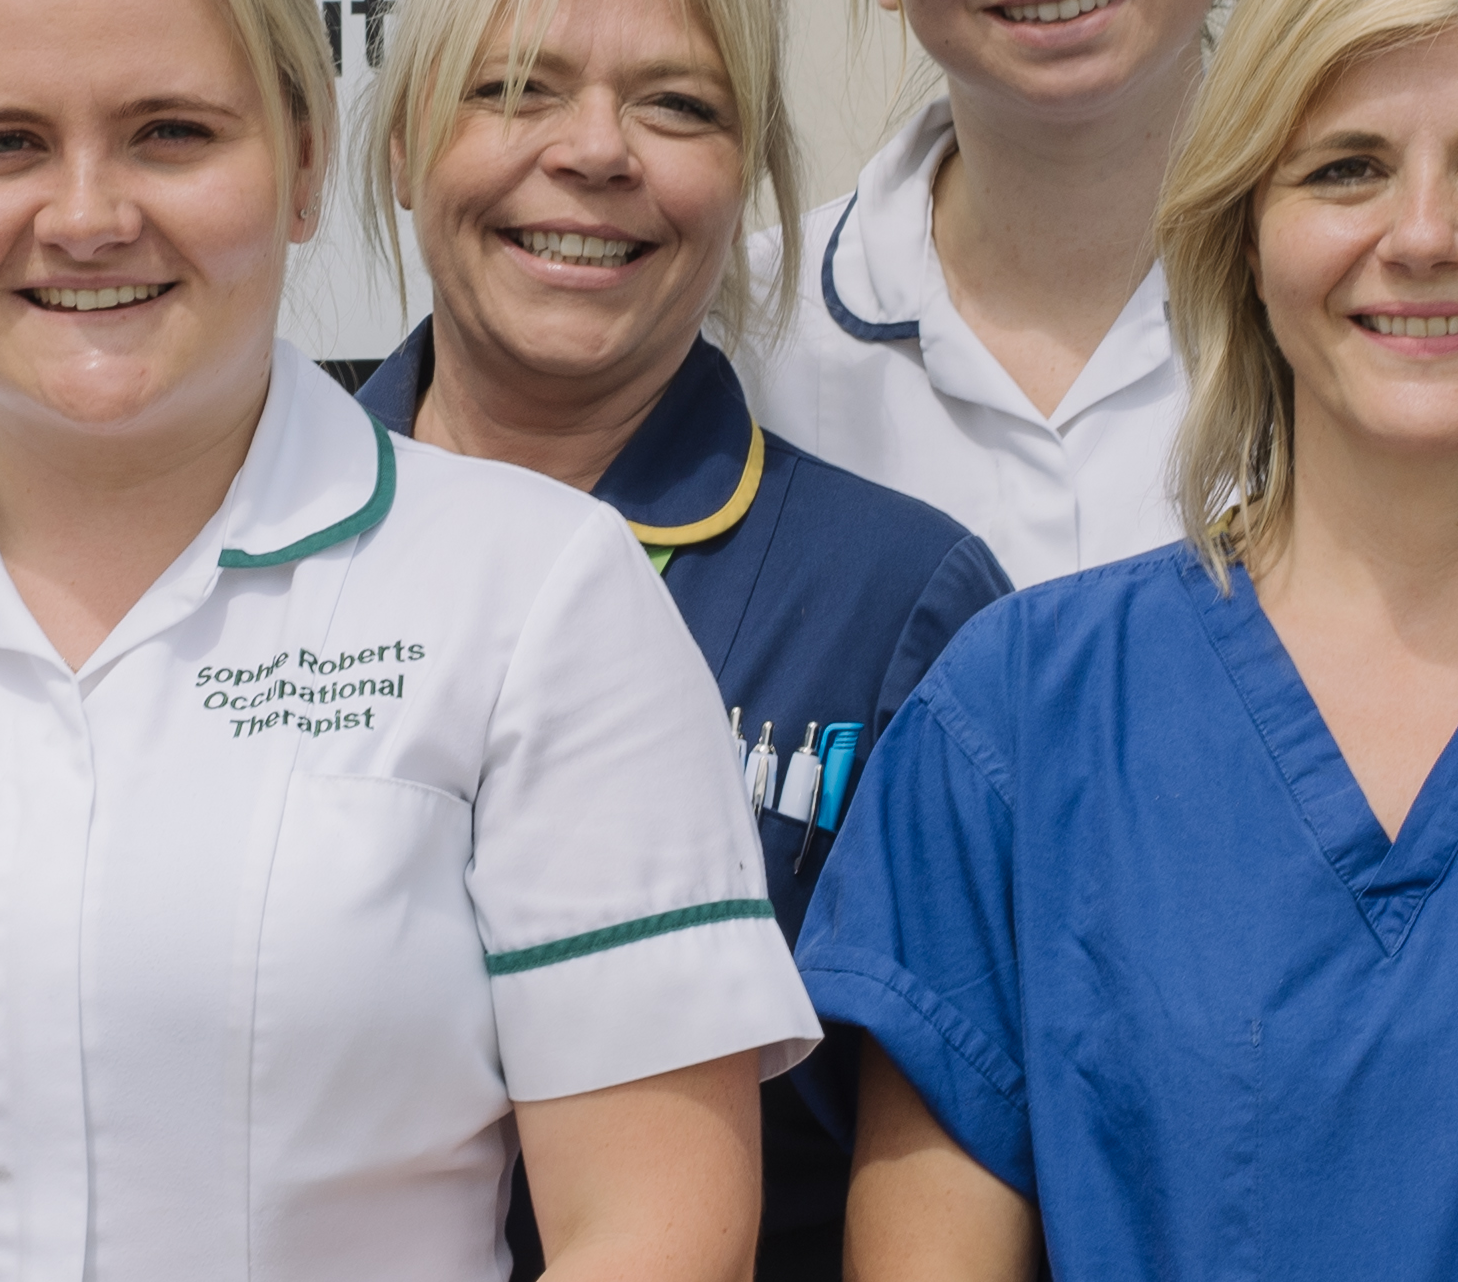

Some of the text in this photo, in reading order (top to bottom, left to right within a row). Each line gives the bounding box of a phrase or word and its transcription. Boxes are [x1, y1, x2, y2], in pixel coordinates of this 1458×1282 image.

[195, 638, 426, 687] Sophie Roberts
[203, 674, 404, 711] Occupational
[229, 706, 376, 739] Therapist
